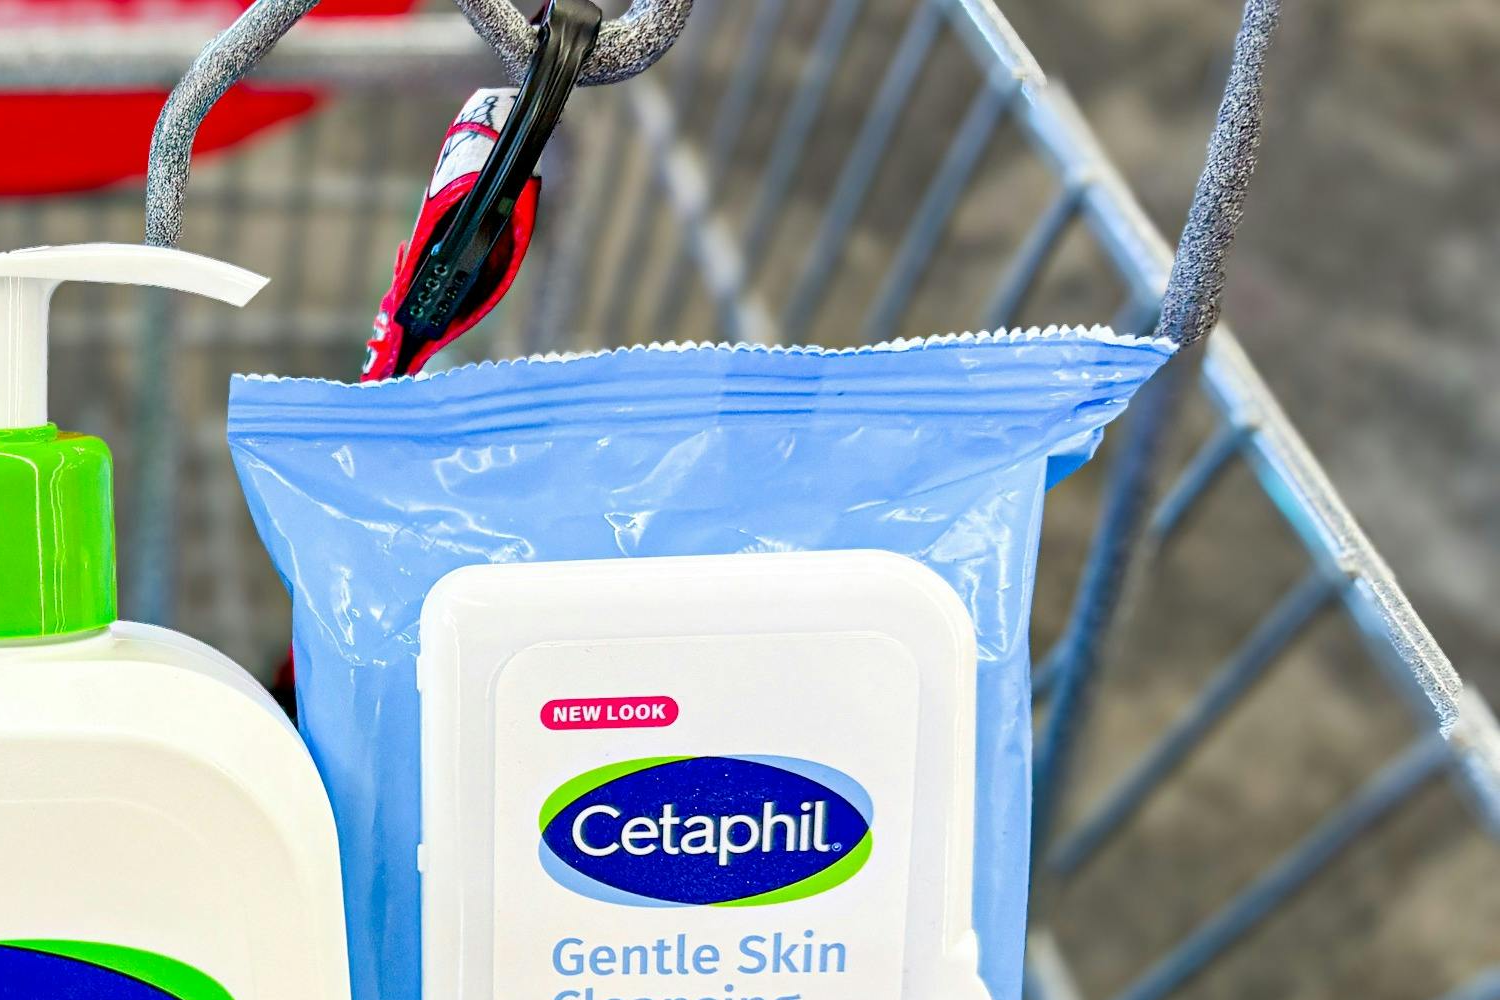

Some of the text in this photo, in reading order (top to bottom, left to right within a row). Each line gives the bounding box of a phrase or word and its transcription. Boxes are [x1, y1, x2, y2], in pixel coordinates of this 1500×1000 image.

[554, 704, 665, 722] NEW LOOK
[553, 930, 846, 976] Gentle Skin
